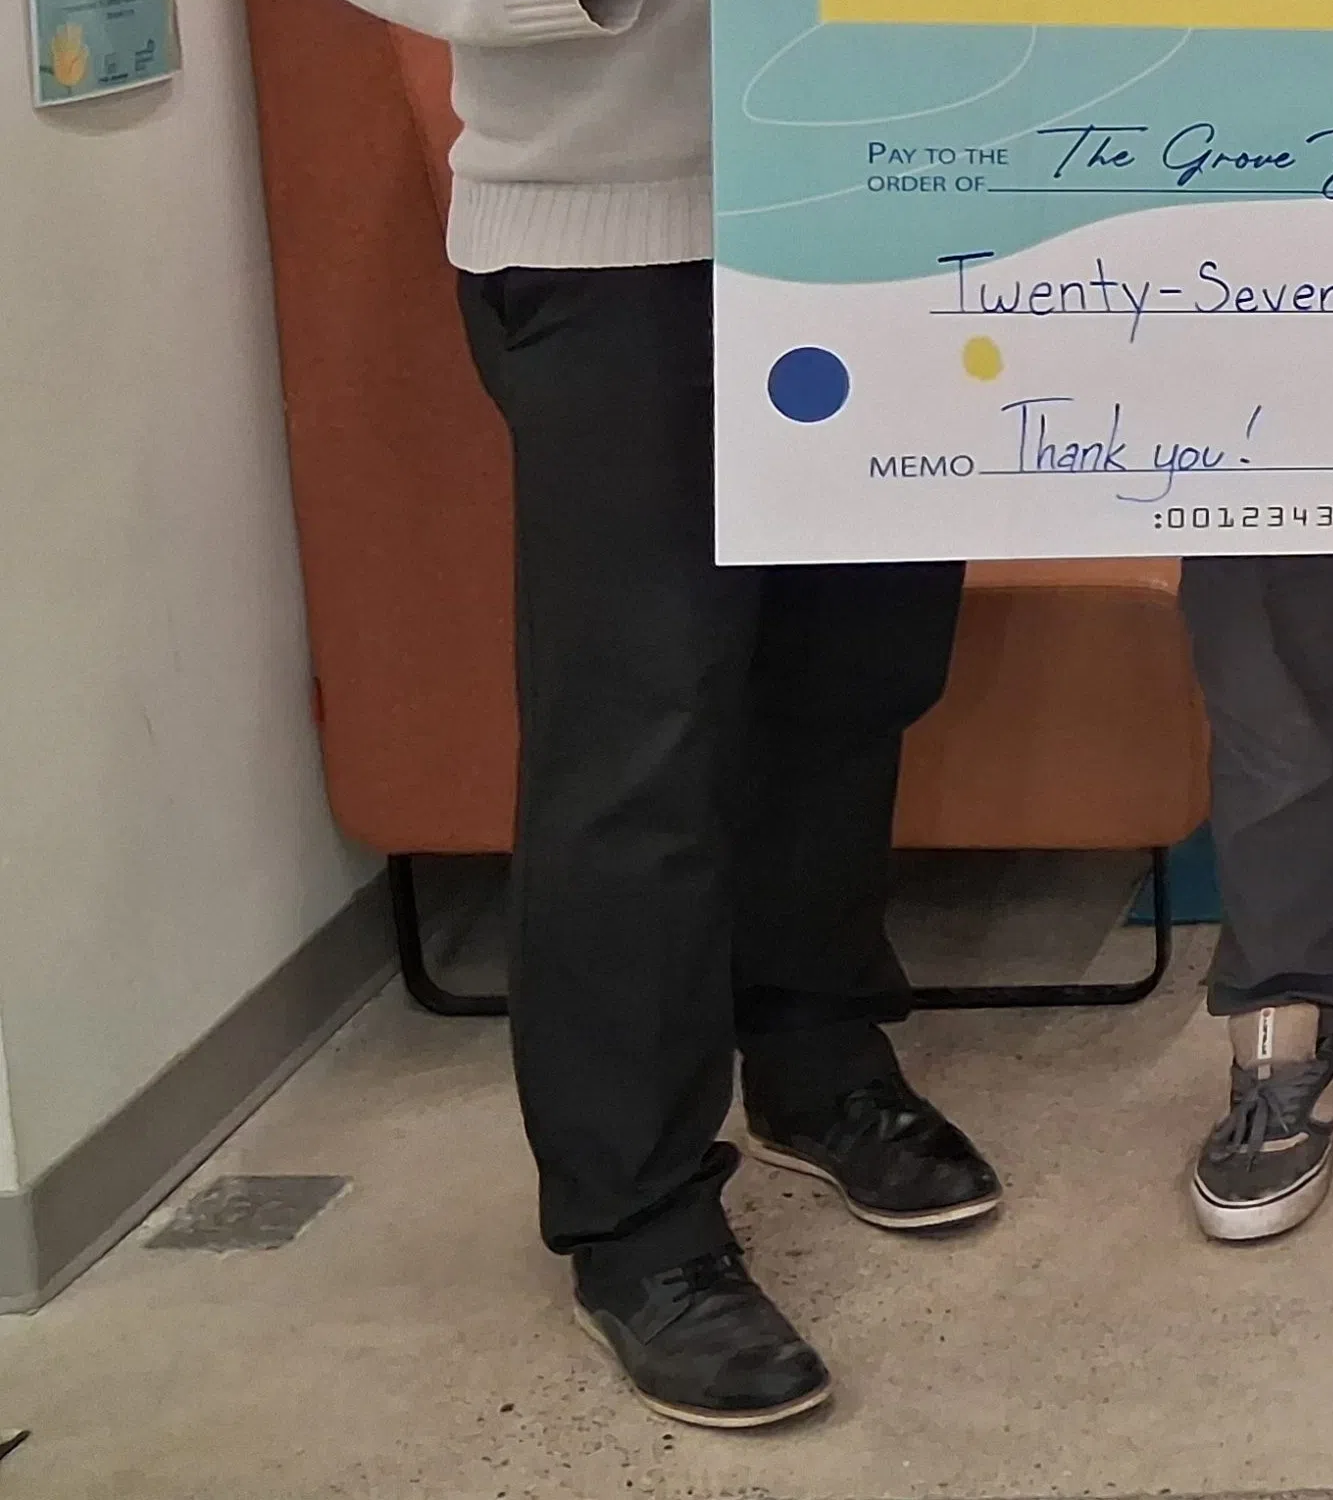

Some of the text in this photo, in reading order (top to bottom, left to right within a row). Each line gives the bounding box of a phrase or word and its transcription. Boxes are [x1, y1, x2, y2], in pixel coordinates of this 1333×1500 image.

[965, 146, 1009, 166] THE
[1037, 123, 1149, 178] The
[1162, 123, 1297, 187] Grove
[867, 174, 986, 193] ORDER OF
[870, 454, 976, 478] MEMO
[1000, 397, 1130, 473] Thank
